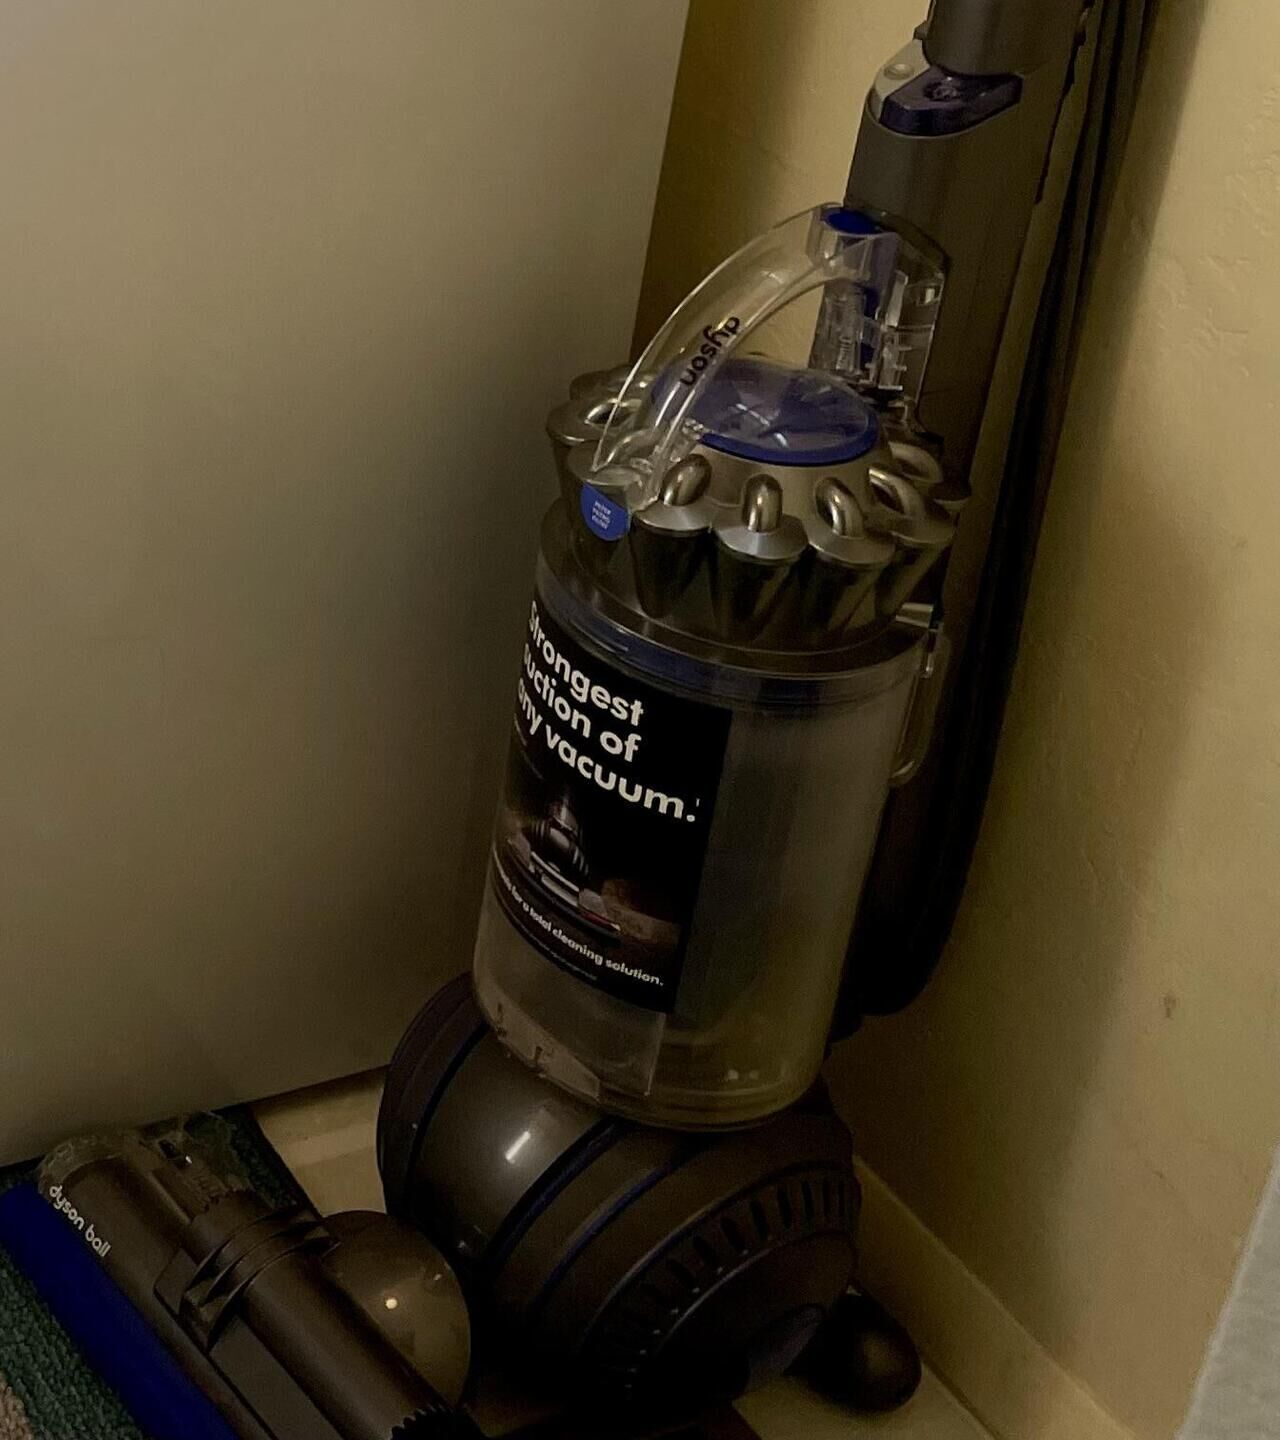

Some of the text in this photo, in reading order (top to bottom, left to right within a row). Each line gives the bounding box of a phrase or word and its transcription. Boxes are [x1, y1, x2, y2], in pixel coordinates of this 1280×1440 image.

[680, 316, 740, 386] dyson
[518, 677, 543, 736] any
[600, 731, 642, 763] of
[552, 928, 603, 966] cleaning
[606, 959, 664, 987] solution.
[49, 1184, 112, 1258] dyson ball
